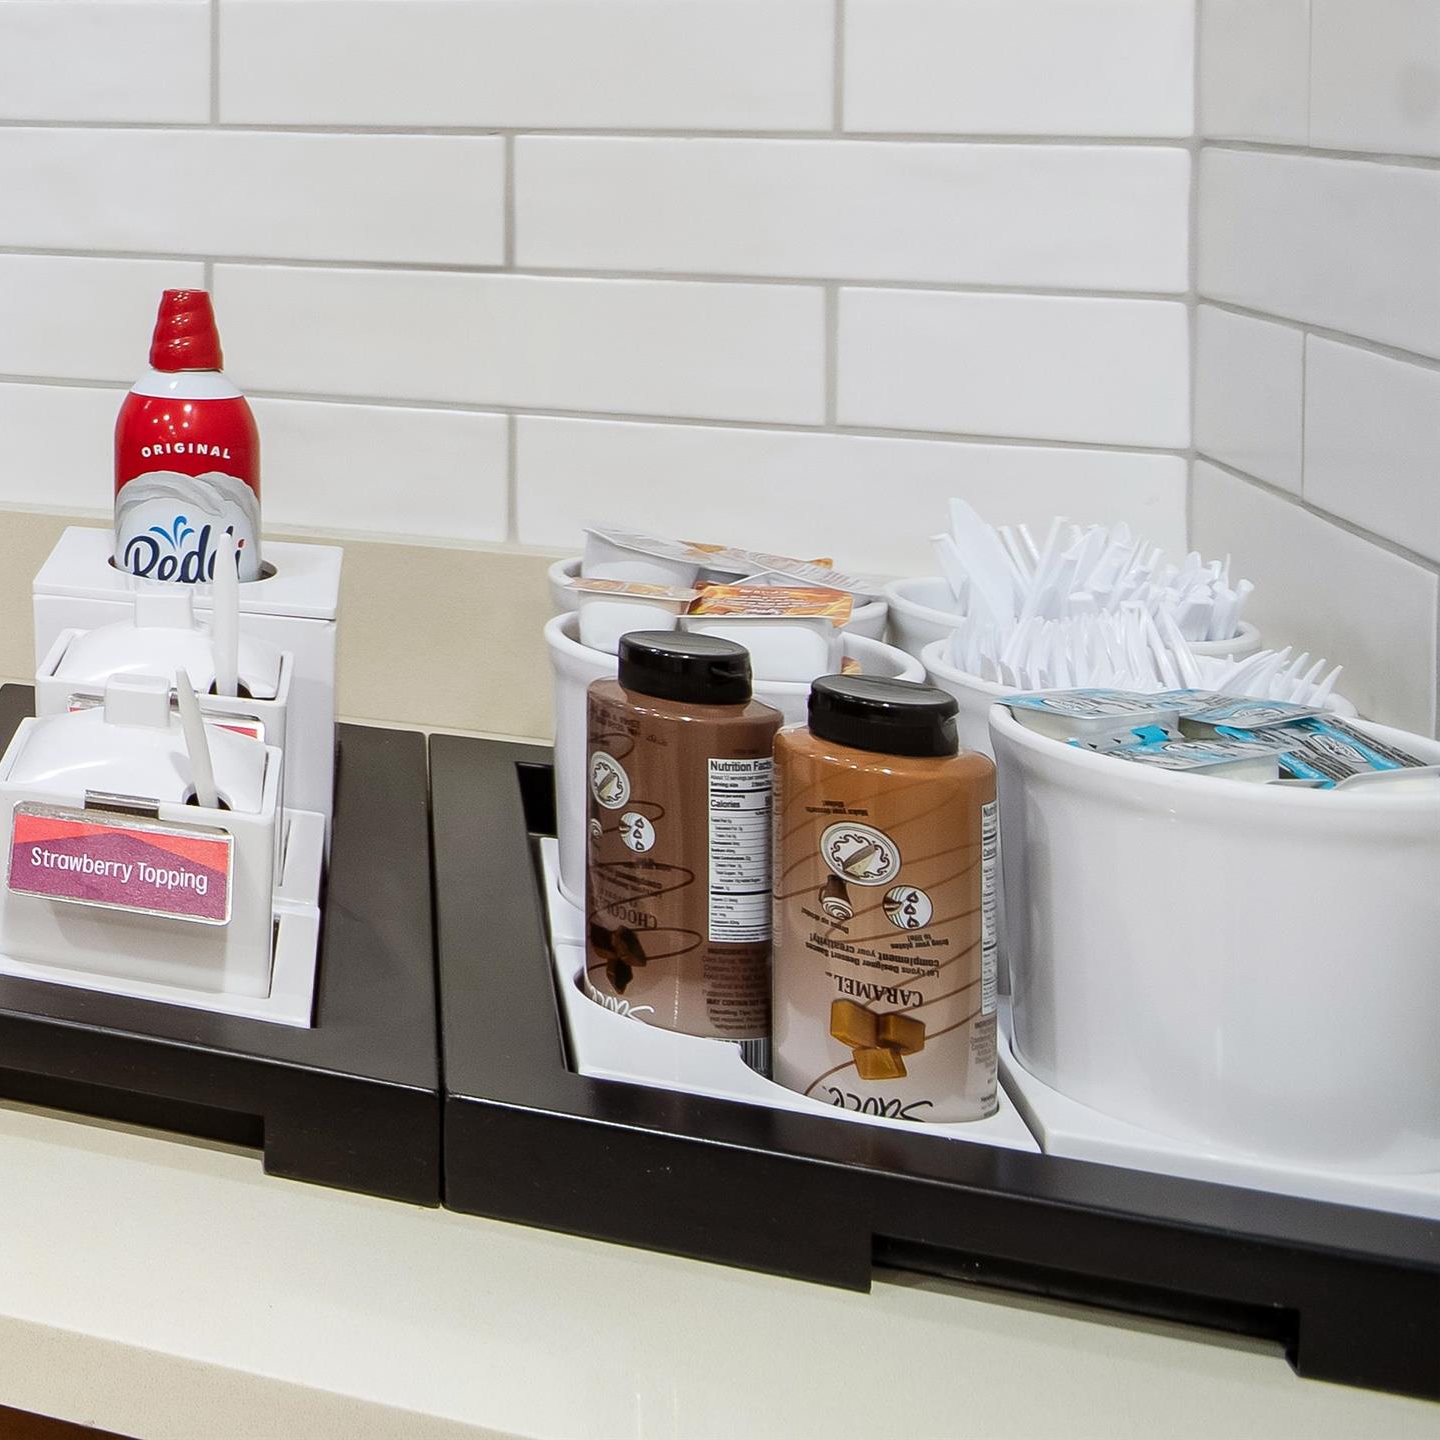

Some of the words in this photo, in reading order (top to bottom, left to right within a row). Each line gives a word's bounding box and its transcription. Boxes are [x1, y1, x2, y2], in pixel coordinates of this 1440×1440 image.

[141, 443, 231, 460] ORIGINAL
[711, 761, 751, 771] Nutrition
[711, 800, 740, 808] Calories
[31, 847, 132, 883] Strawberry
[137, 862, 208, 895] Topping
[810, 933, 855, 953] creativity!
[831, 951, 860, 966] Dessert
[857, 949, 875, 957] your
[878, 952, 939, 967] complement
[862, 960, 899, 974] Designer
[834, 974, 924, 1008] CARAMEL
